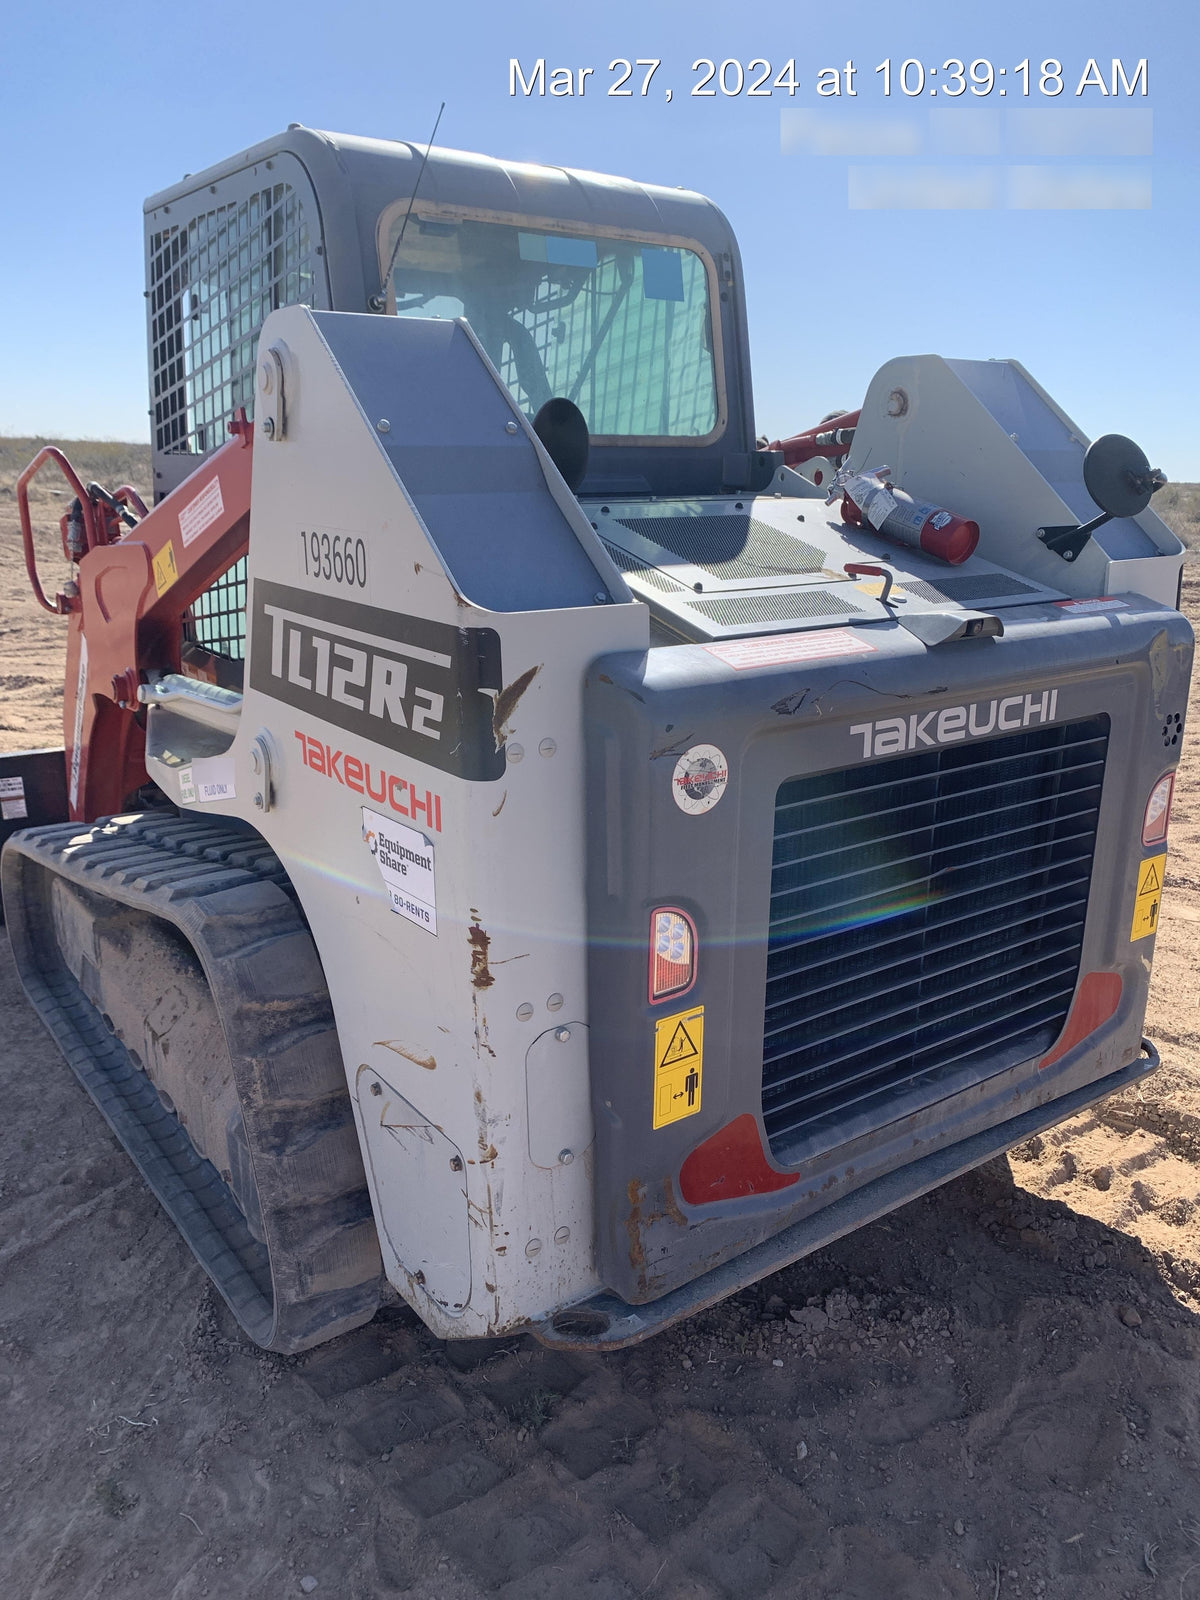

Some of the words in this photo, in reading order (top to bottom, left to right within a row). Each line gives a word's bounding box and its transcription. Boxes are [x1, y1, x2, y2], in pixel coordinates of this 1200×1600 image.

[300, 531, 367, 588] 193660
[263, 603, 452, 741] TL12R2
[378, 832, 432, 872] Equipment
[379, 849, 408, 876] Share
